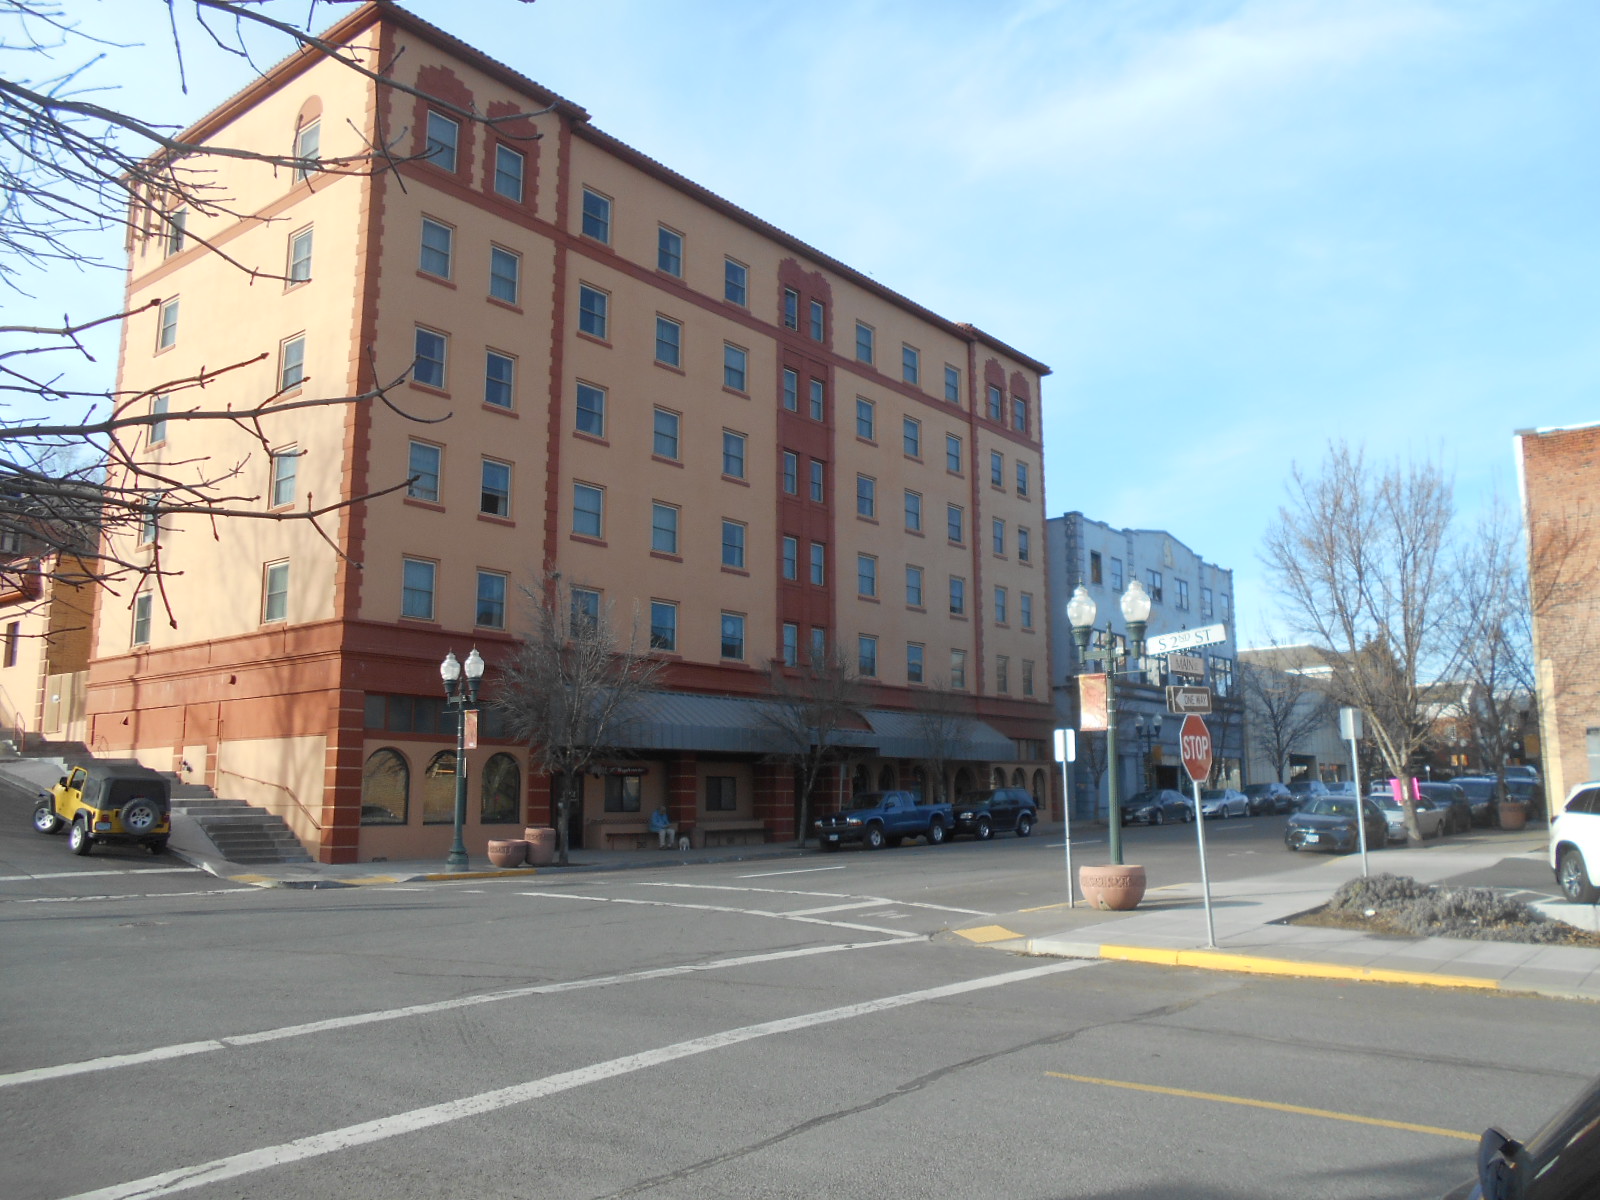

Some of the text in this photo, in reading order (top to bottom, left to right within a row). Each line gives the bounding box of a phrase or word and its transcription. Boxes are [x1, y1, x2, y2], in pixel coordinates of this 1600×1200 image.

[1158, 638, 1167, 651] S
[1194, 629, 1211, 644] ST
[1175, 658, 1194, 671] MAIN
[1184, 694, 1207, 705] ONE WAY
[1183, 735, 1209, 760] STOP
